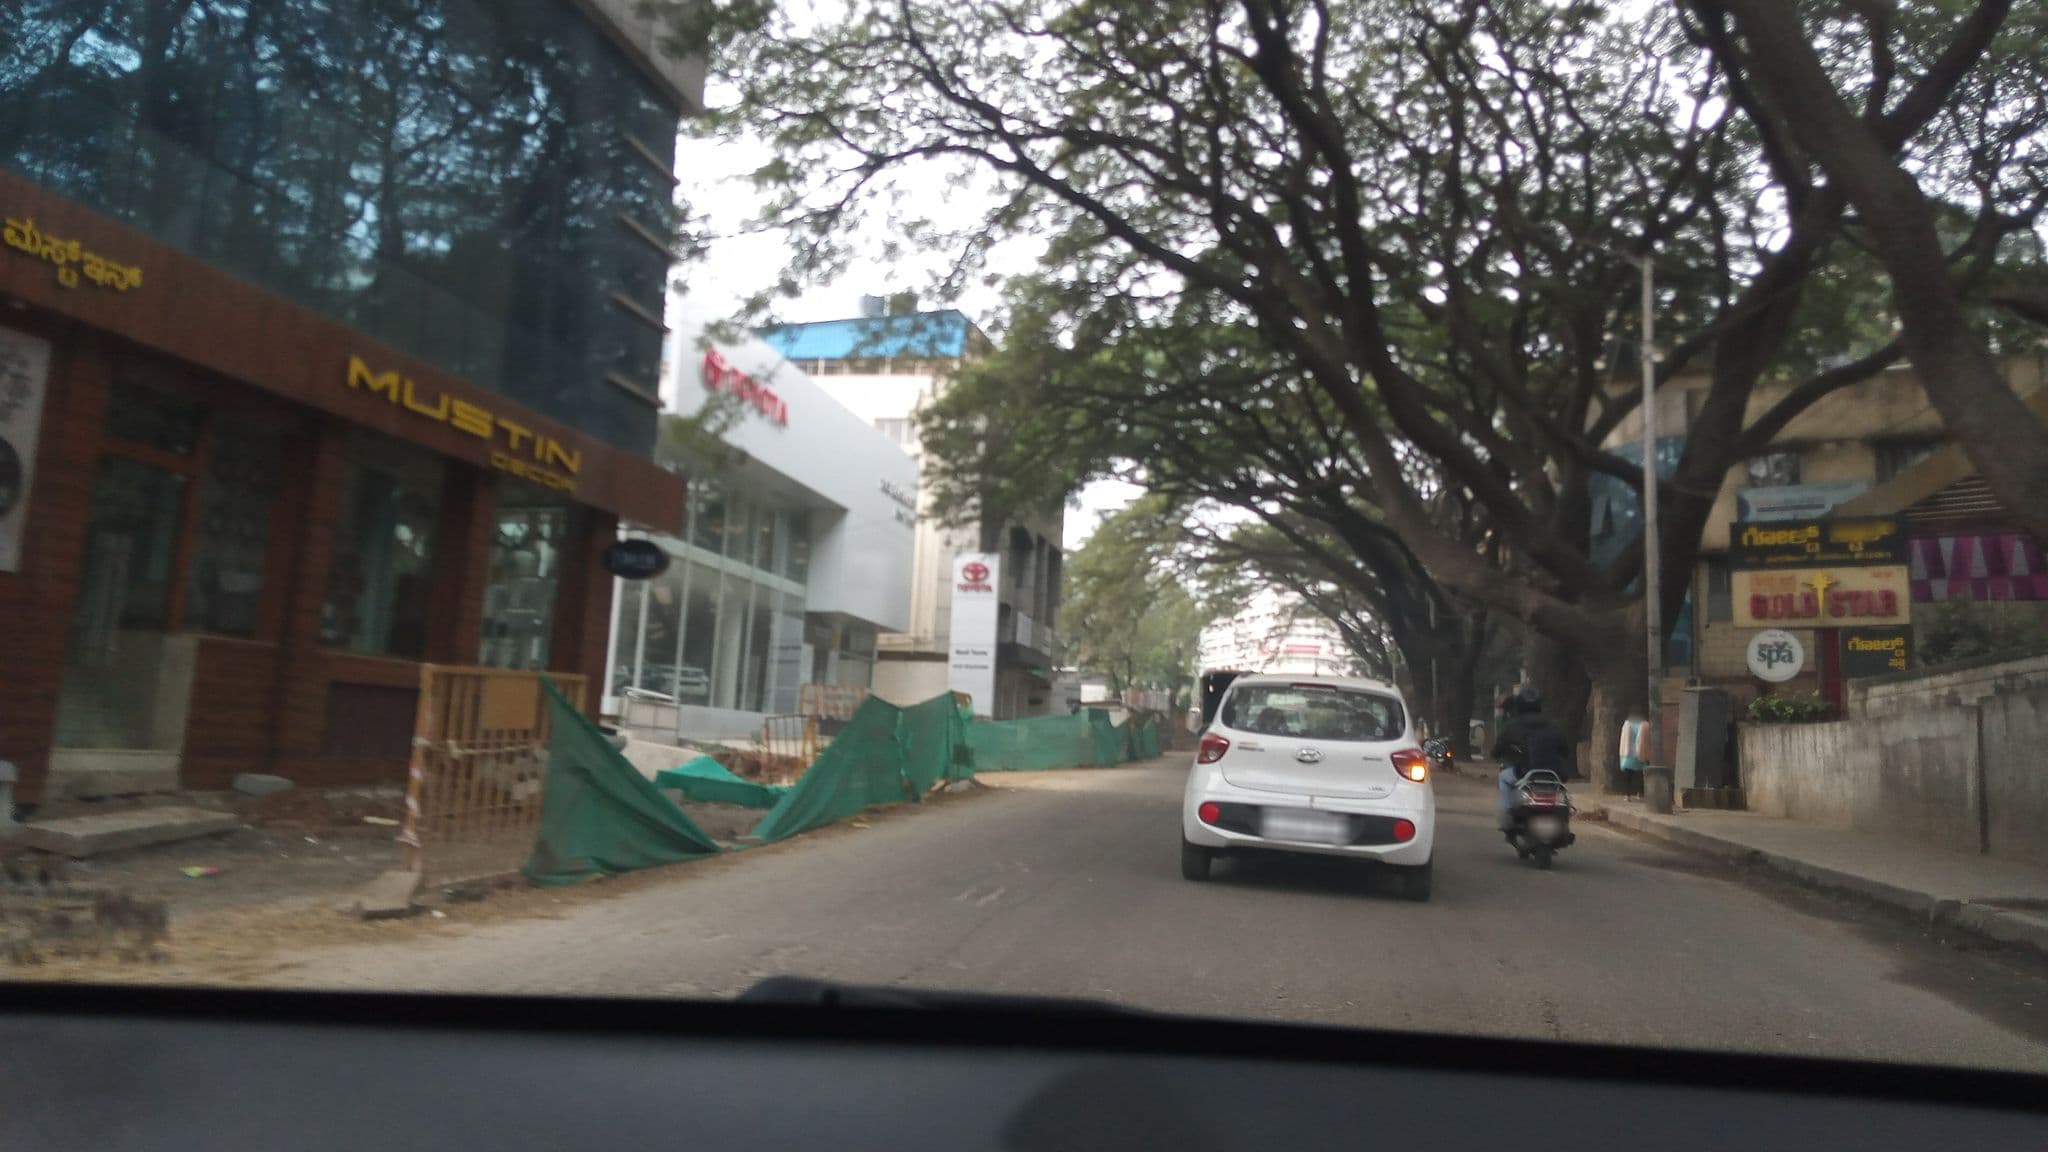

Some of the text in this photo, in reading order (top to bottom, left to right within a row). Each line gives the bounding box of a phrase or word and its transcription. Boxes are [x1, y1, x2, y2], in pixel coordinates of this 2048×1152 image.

[347, 355, 582, 474] MUSTIN
[957, 582, 993, 593] TOYOTA
[1756, 646, 1795, 670] spa
